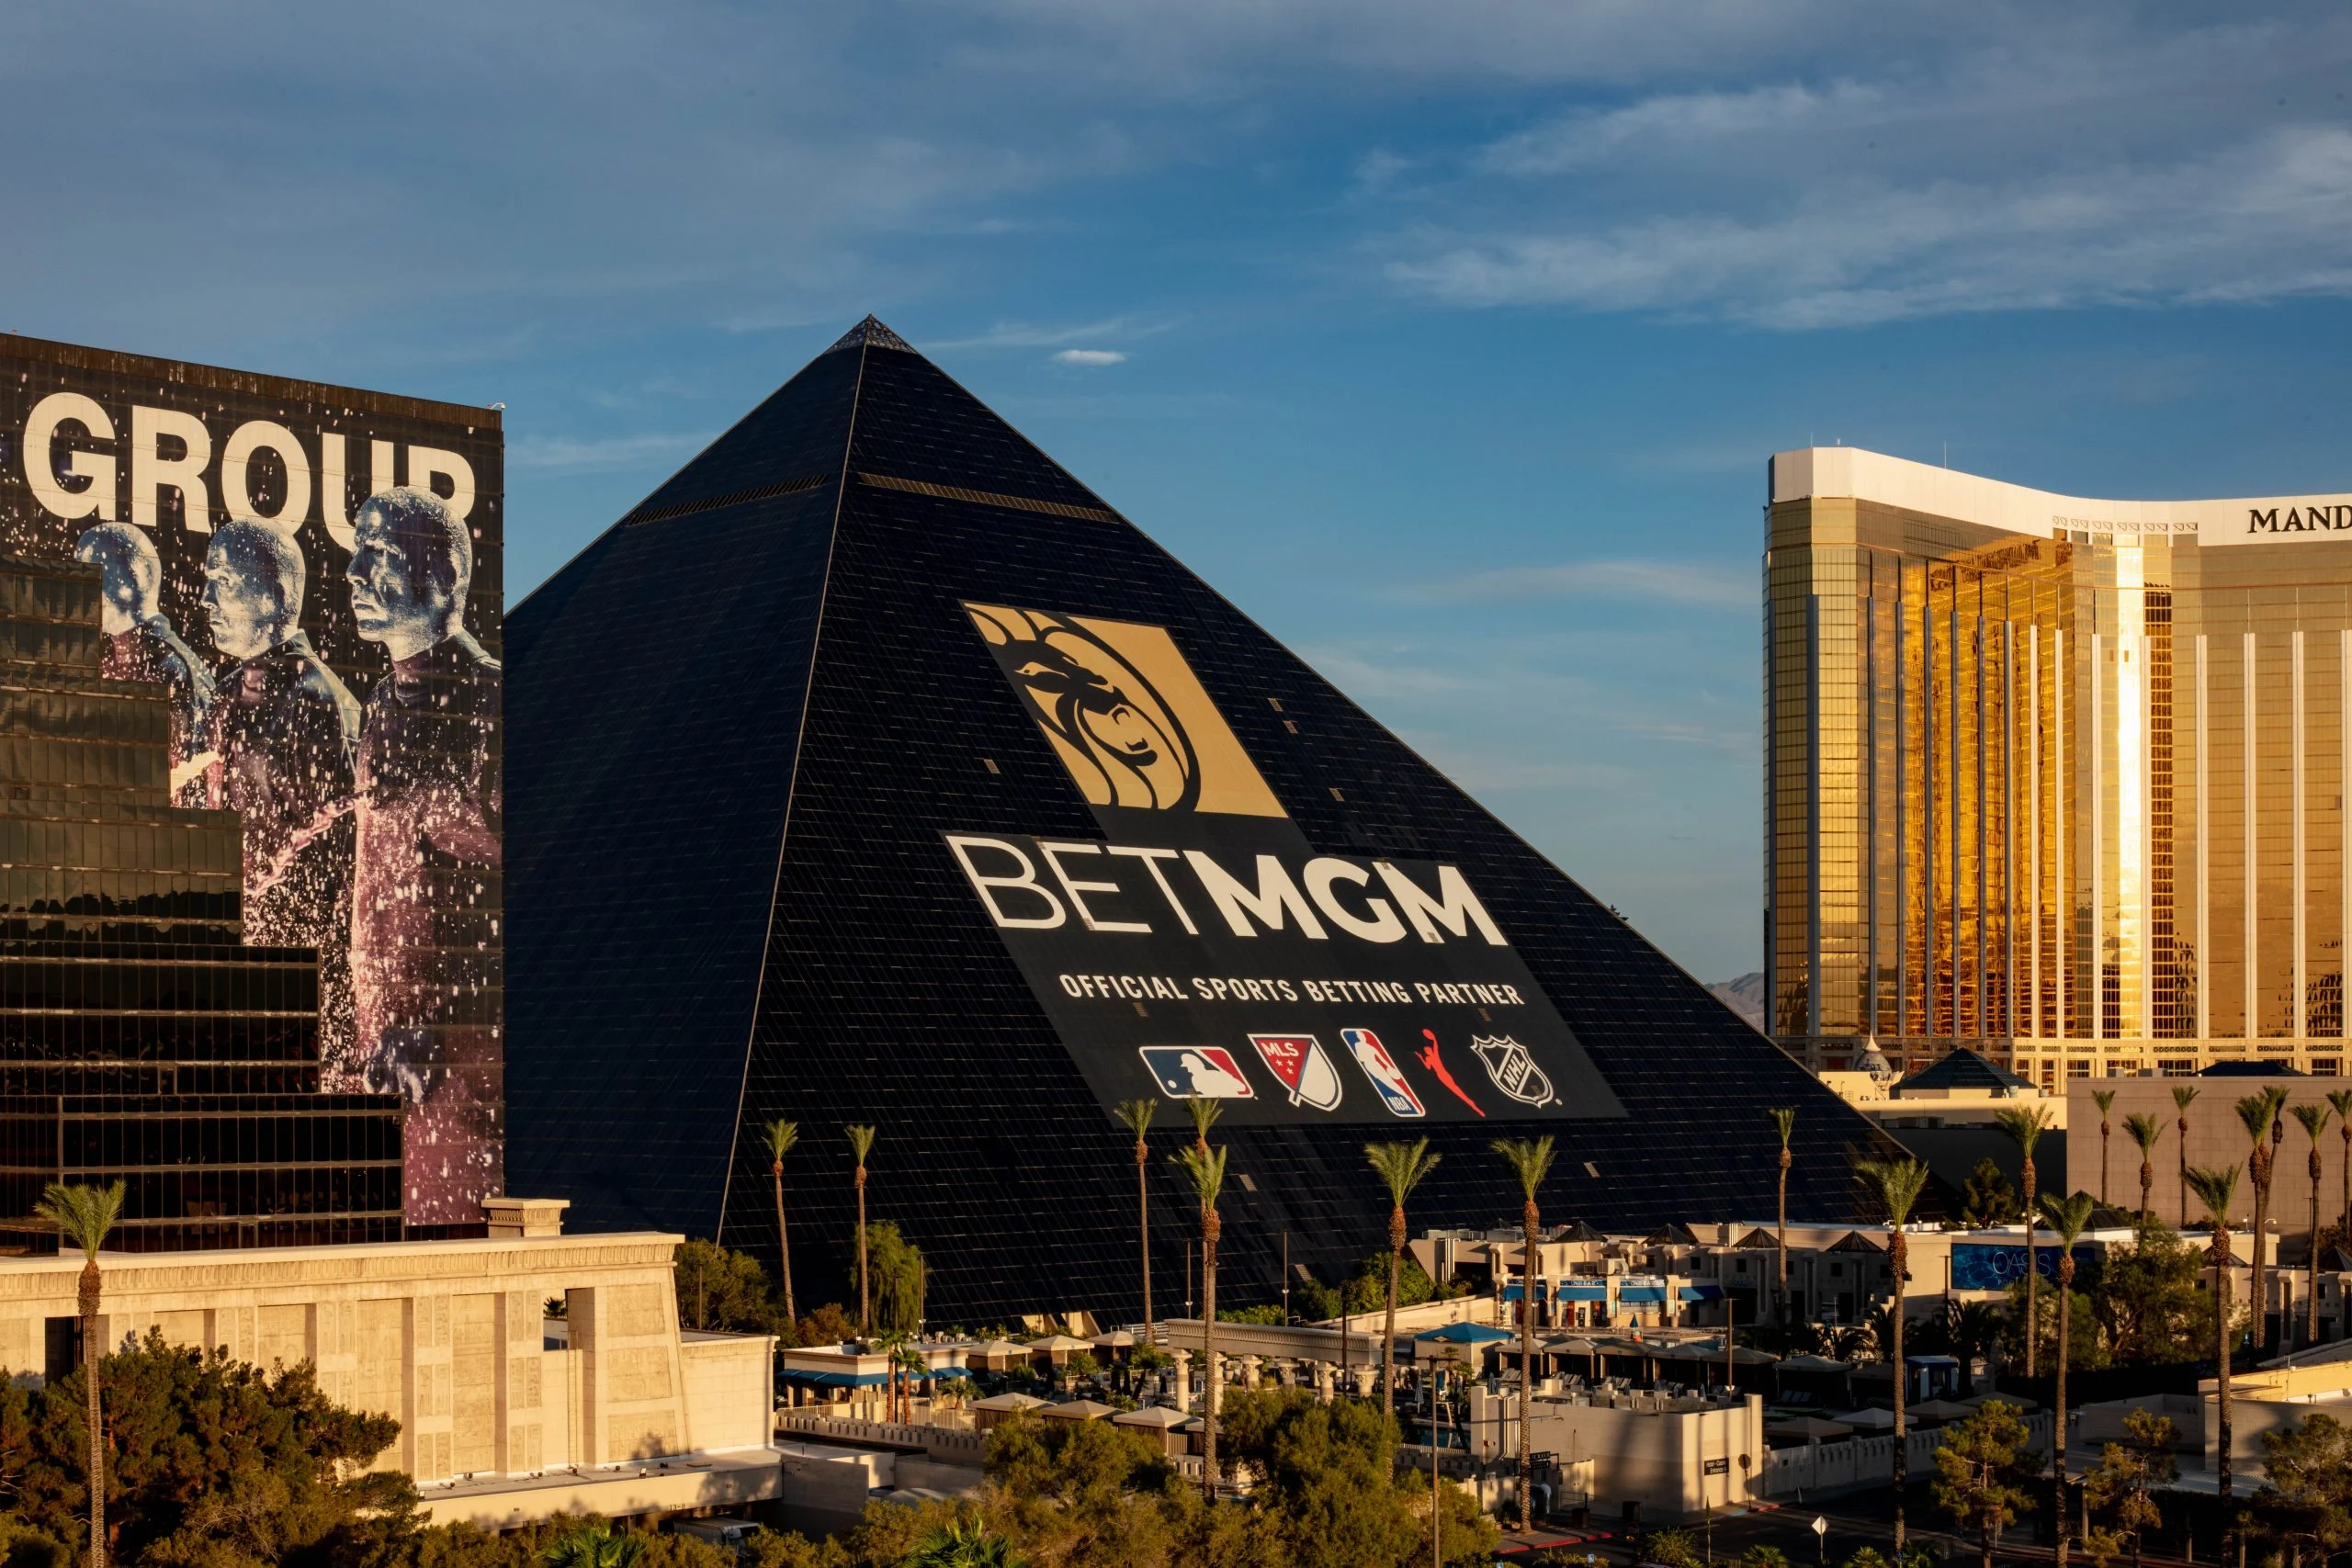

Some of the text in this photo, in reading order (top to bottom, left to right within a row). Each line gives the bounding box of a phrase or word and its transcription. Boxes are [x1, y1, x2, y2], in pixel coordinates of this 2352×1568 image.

[2247, 505, 2352, 534] MAND
[945, 834, 1510, 946] BETMGM
[1059, 974, 1525, 1005] OFFICIAL SPORTS BETTING PARTNER
[1261, 1042, 1299, 1057] MLS
[1503, 1054, 1526, 1091] NHL
[1387, 1096, 1412, 1111] NBA
[1992, 1251, 2051, 1276] OASS
